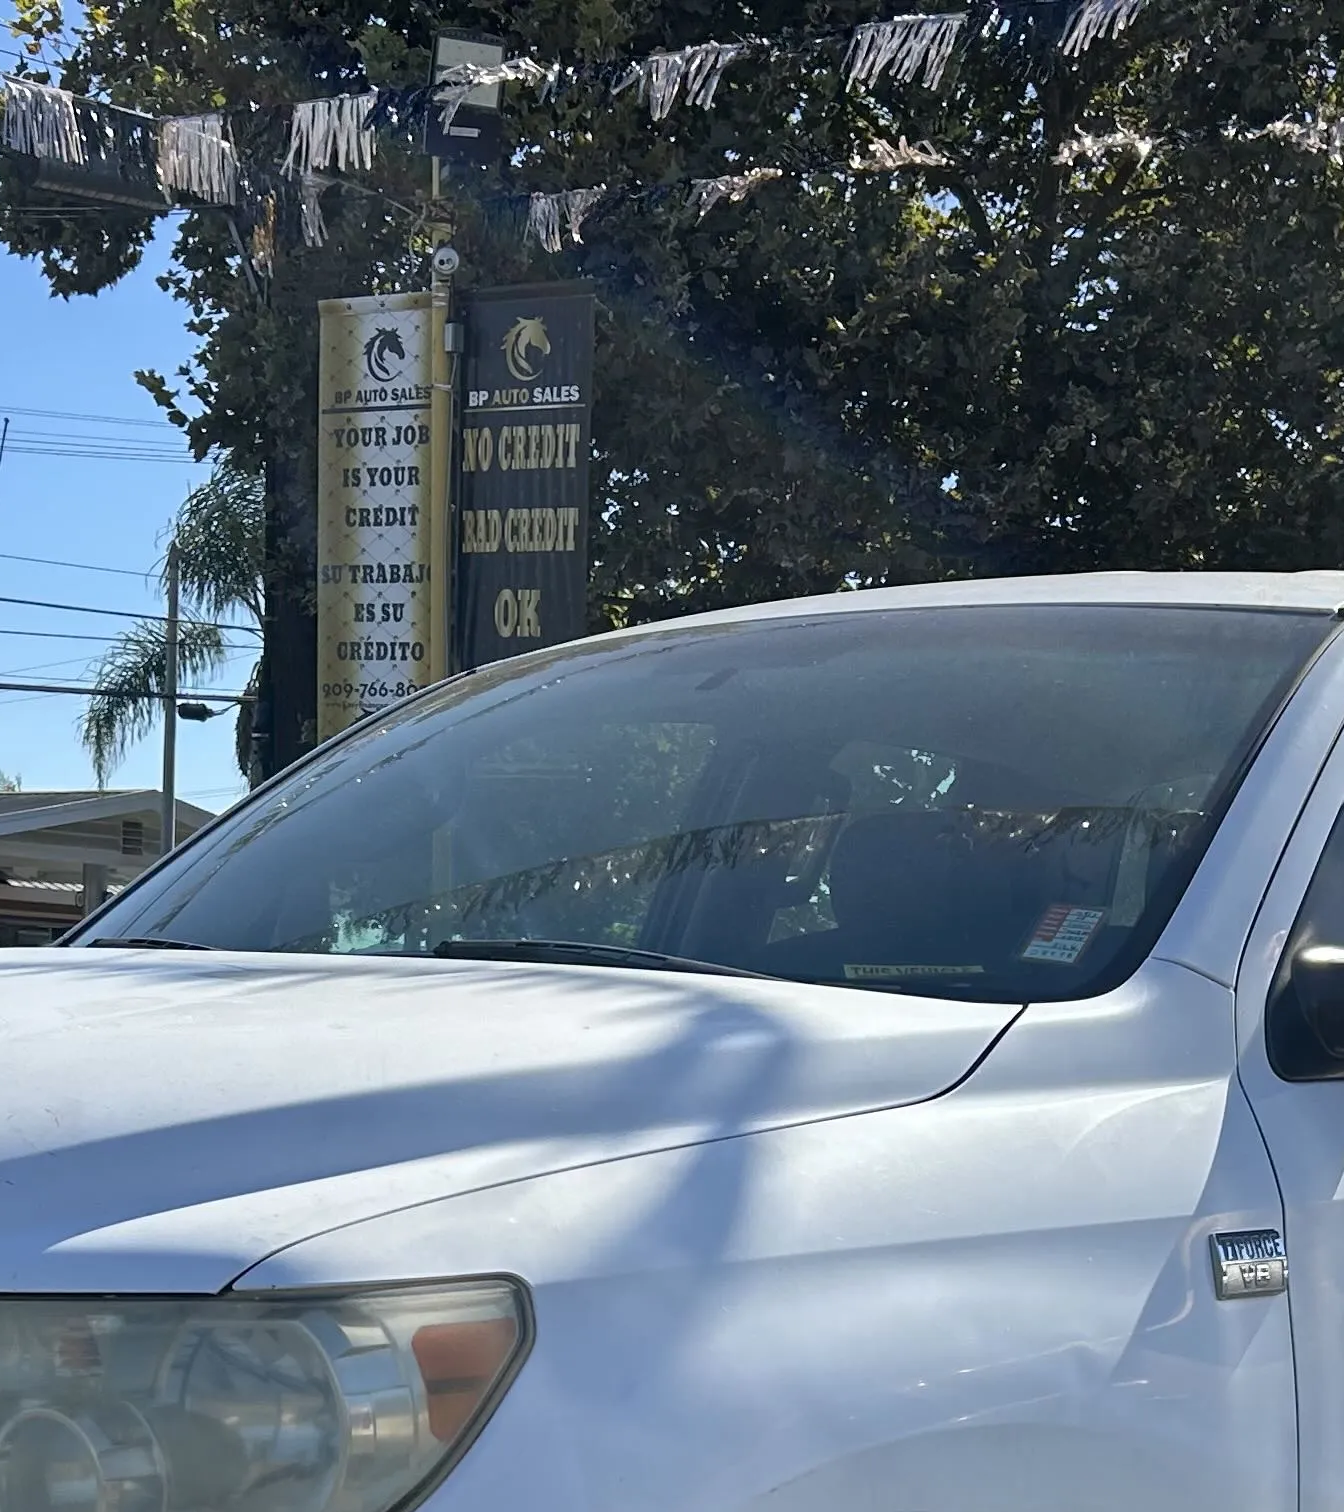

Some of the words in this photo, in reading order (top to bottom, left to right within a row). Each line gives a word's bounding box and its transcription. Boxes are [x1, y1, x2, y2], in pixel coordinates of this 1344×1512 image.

[335, 389, 352, 404] BP
[356, 387, 387, 403] AUTO
[391, 385, 431, 401] SALES
[469, 390, 489, 407] BP
[492, 388, 529, 405] AUTO
[532, 385, 580, 402] SALES
[333, 427, 387, 448] YOUR
[391, 425, 430, 446] JOB
[462, 427, 493, 472] NO
[498, 423, 581, 471] CREDIT
[343, 468, 361, 487] IS
[367, 466, 420, 486] YOUR
[345, 507, 419, 527] CREDIT
[462, 509, 504, 553] BAD
[505, 507, 580, 552] CREDIT
[321, 565, 342, 585] SU
[354, 603, 376, 622] ES
[382, 603, 405, 622] SU
[494, 589, 541, 638] OK
[336, 636, 424, 661] CRÉDITO
